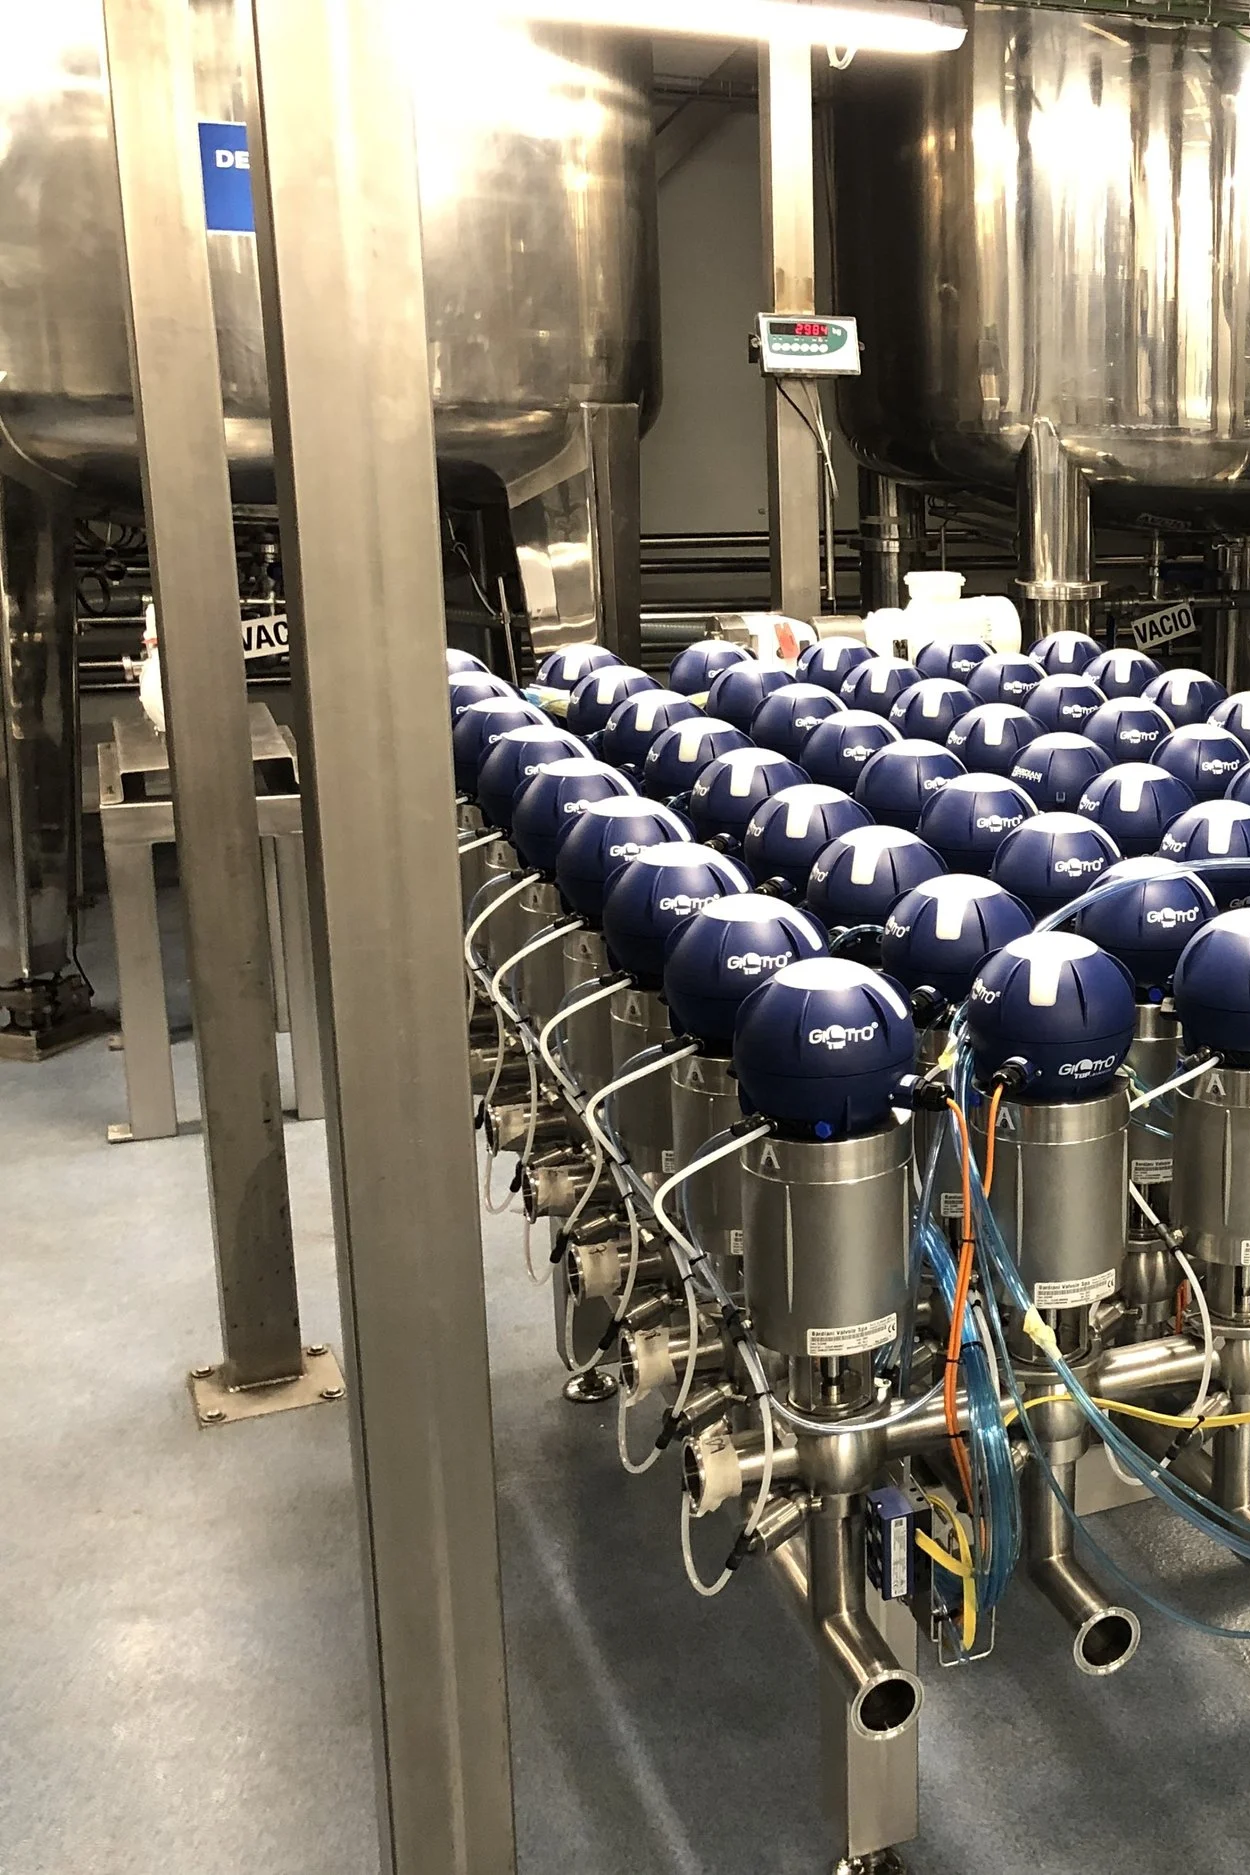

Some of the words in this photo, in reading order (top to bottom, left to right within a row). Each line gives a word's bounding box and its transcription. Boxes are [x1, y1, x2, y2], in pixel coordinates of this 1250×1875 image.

[242, 621, 289, 652] VAC
[1134, 608, 1191, 644] VACIO
[809, 1022, 878, 1045] GIOTTO
[1058, 1054, 1116, 1076] GIOTTO
